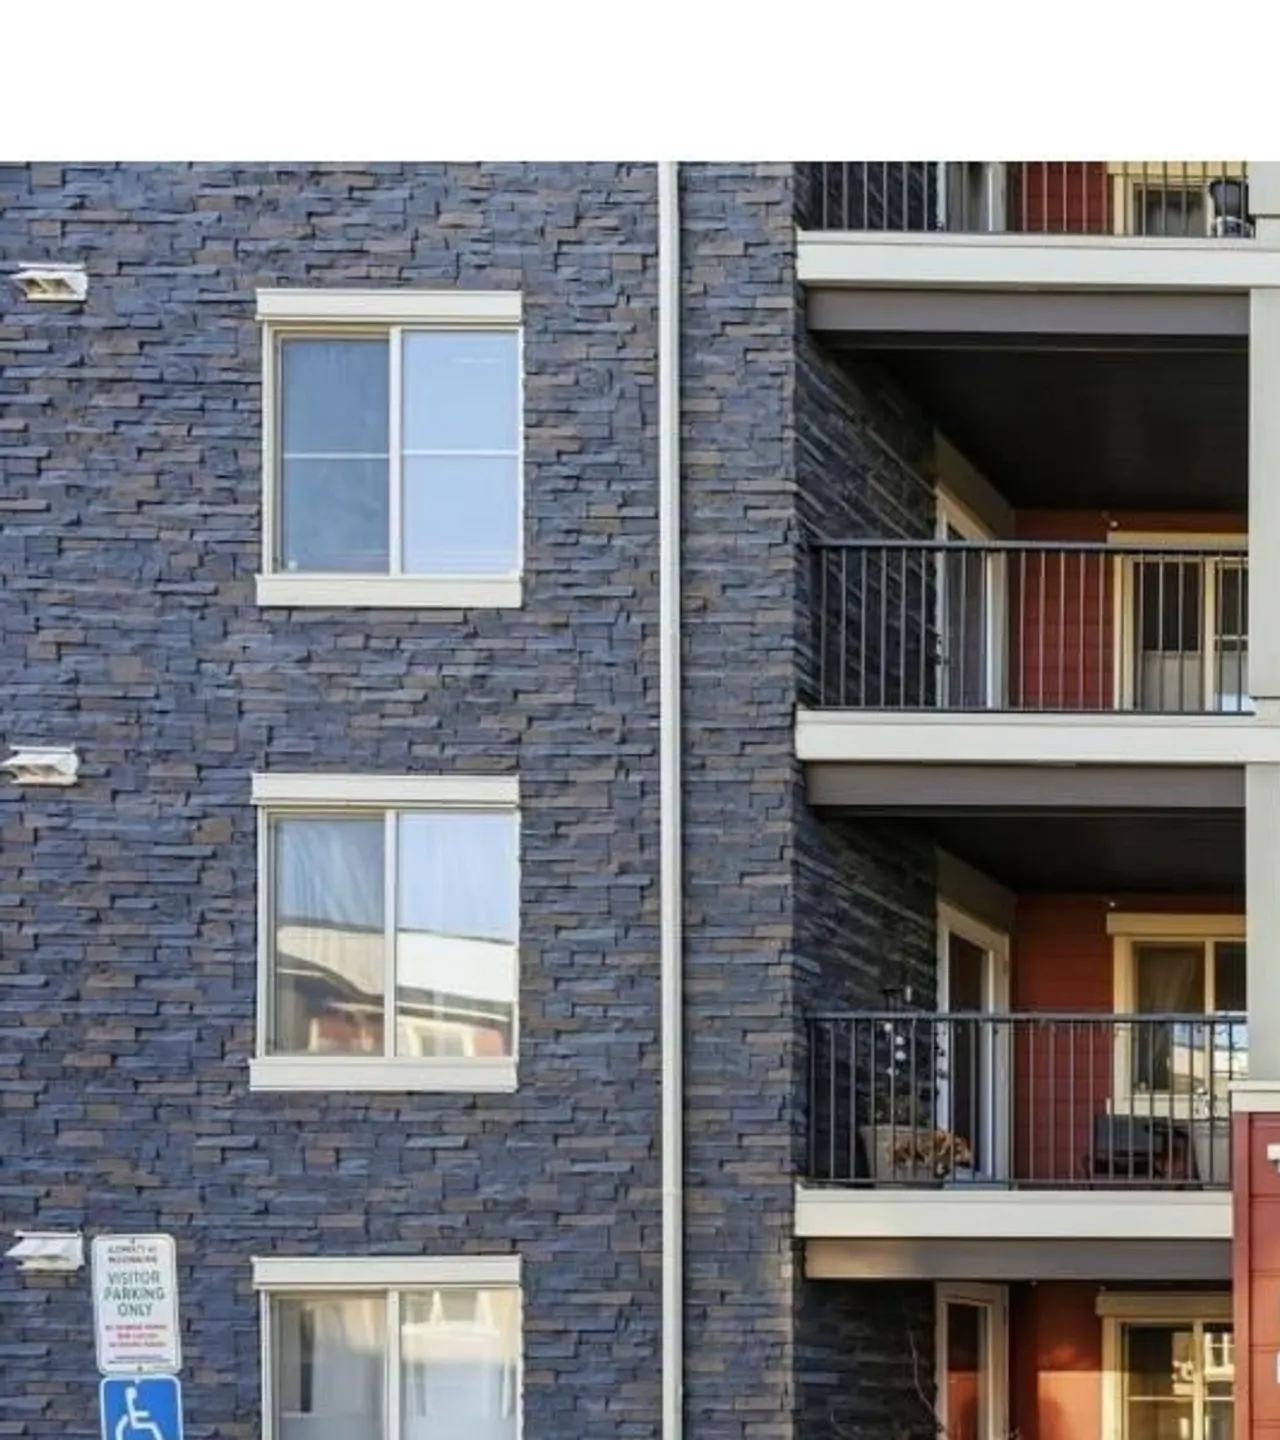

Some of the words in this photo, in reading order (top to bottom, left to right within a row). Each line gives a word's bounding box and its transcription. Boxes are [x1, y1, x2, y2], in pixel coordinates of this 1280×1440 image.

[108, 1270, 161, 1285] VISITOR
[103, 1286, 165, 1300] PARKING
[118, 1303, 152, 1317] ONLY
